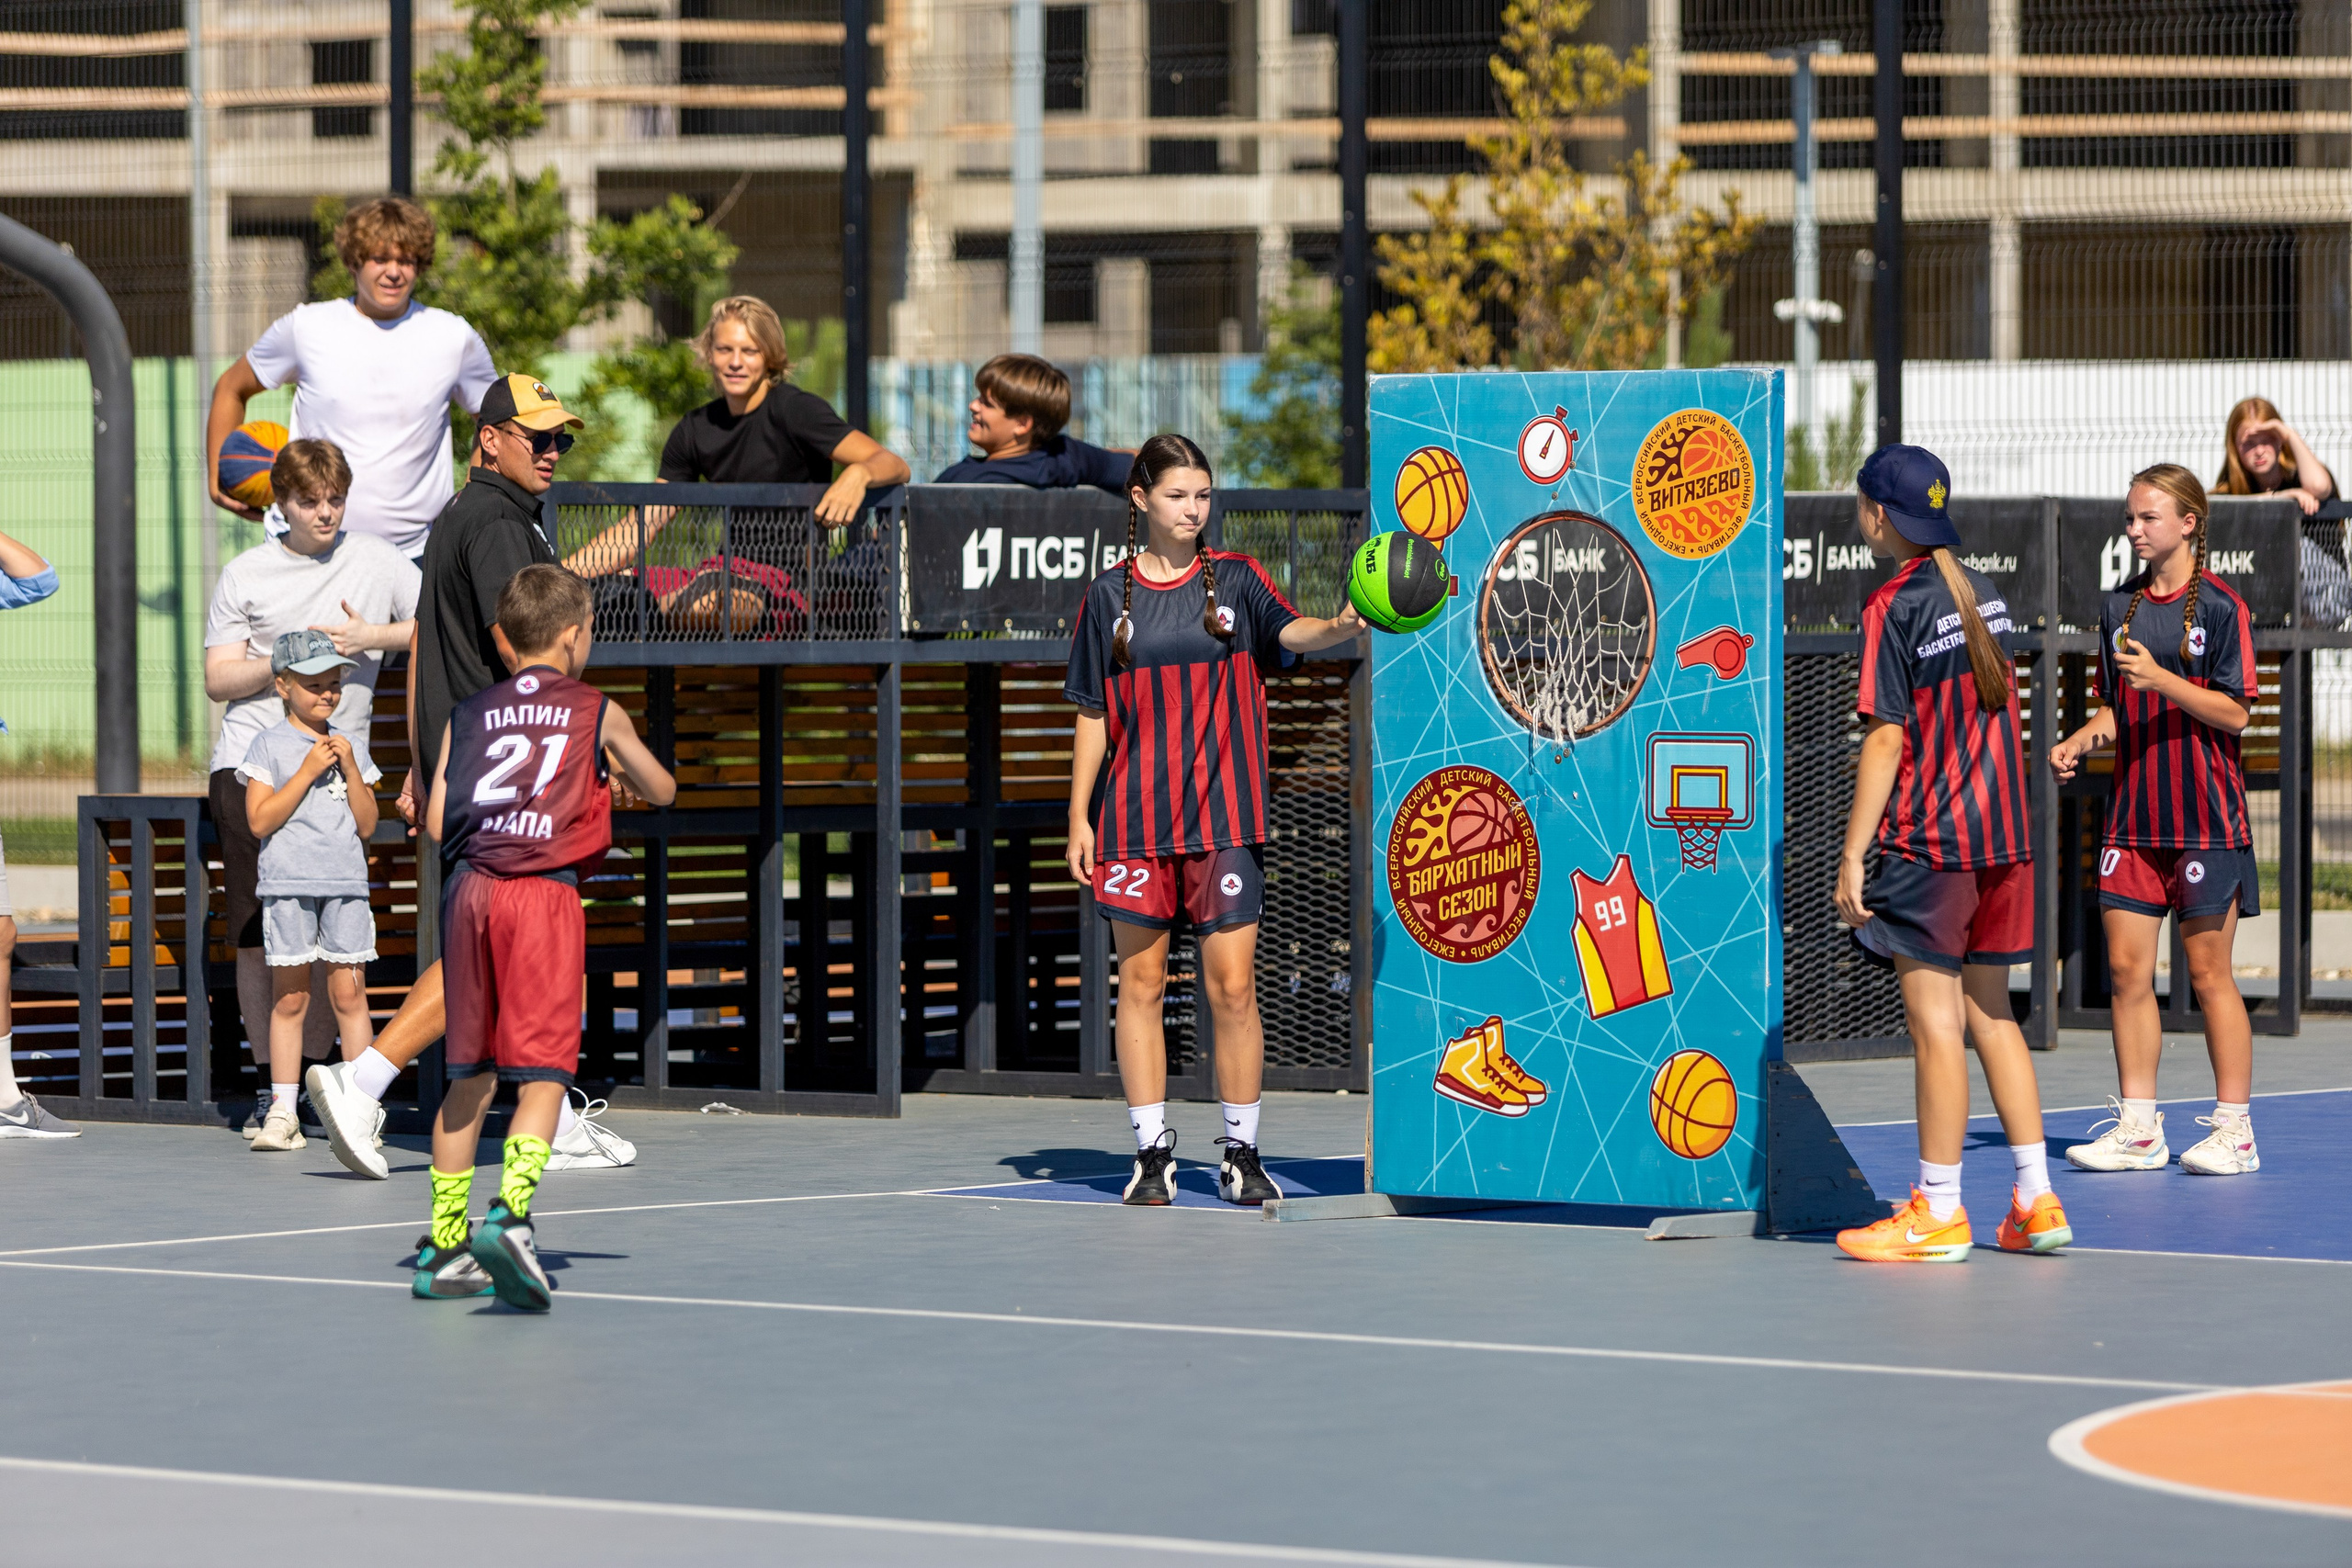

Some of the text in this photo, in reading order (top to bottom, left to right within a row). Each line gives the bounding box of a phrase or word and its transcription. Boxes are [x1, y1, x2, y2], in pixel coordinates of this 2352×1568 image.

[1636, 413, 1751, 554] ЕЖЕГОДНЫЙ ВСЕРОССИЙСКИЙ ДЕТСКИЙ БАСКЕТБОЛЬНЫЙ ФЕСТИВАЛЬ
[1648, 467, 1740, 513] ВИТЯЗЕВО
[1011, 536, 1086, 580] ПСБ
[1366, 548, 1377, 575] МБ
[1485, 539, 1539, 581] СБ
[1554, 548, 1606, 573] БАНК
[1826, 544, 1876, 571] БАНК
[2211, 549, 2255, 575] БАНК
[484, 705, 571, 731] ПАПИН
[472, 733, 571, 805] 21
[1103, 863, 1151, 897] 22
[1390, 769, 1537, 958] ЕЖЕГОДНЫЙ ВСЕРОССИЙСКИЙ ДЕТСКИЙ БАСКЕТБОЛЬНЫЙ ФЕСТИВАЛЬ
[1406, 839, 1521, 897] БАРХАТНЫЙ
[2099, 847, 2121, 877] 0
[1438, 882, 1498, 921] СЕЗОН
[1594, 895, 1628, 932] 99
